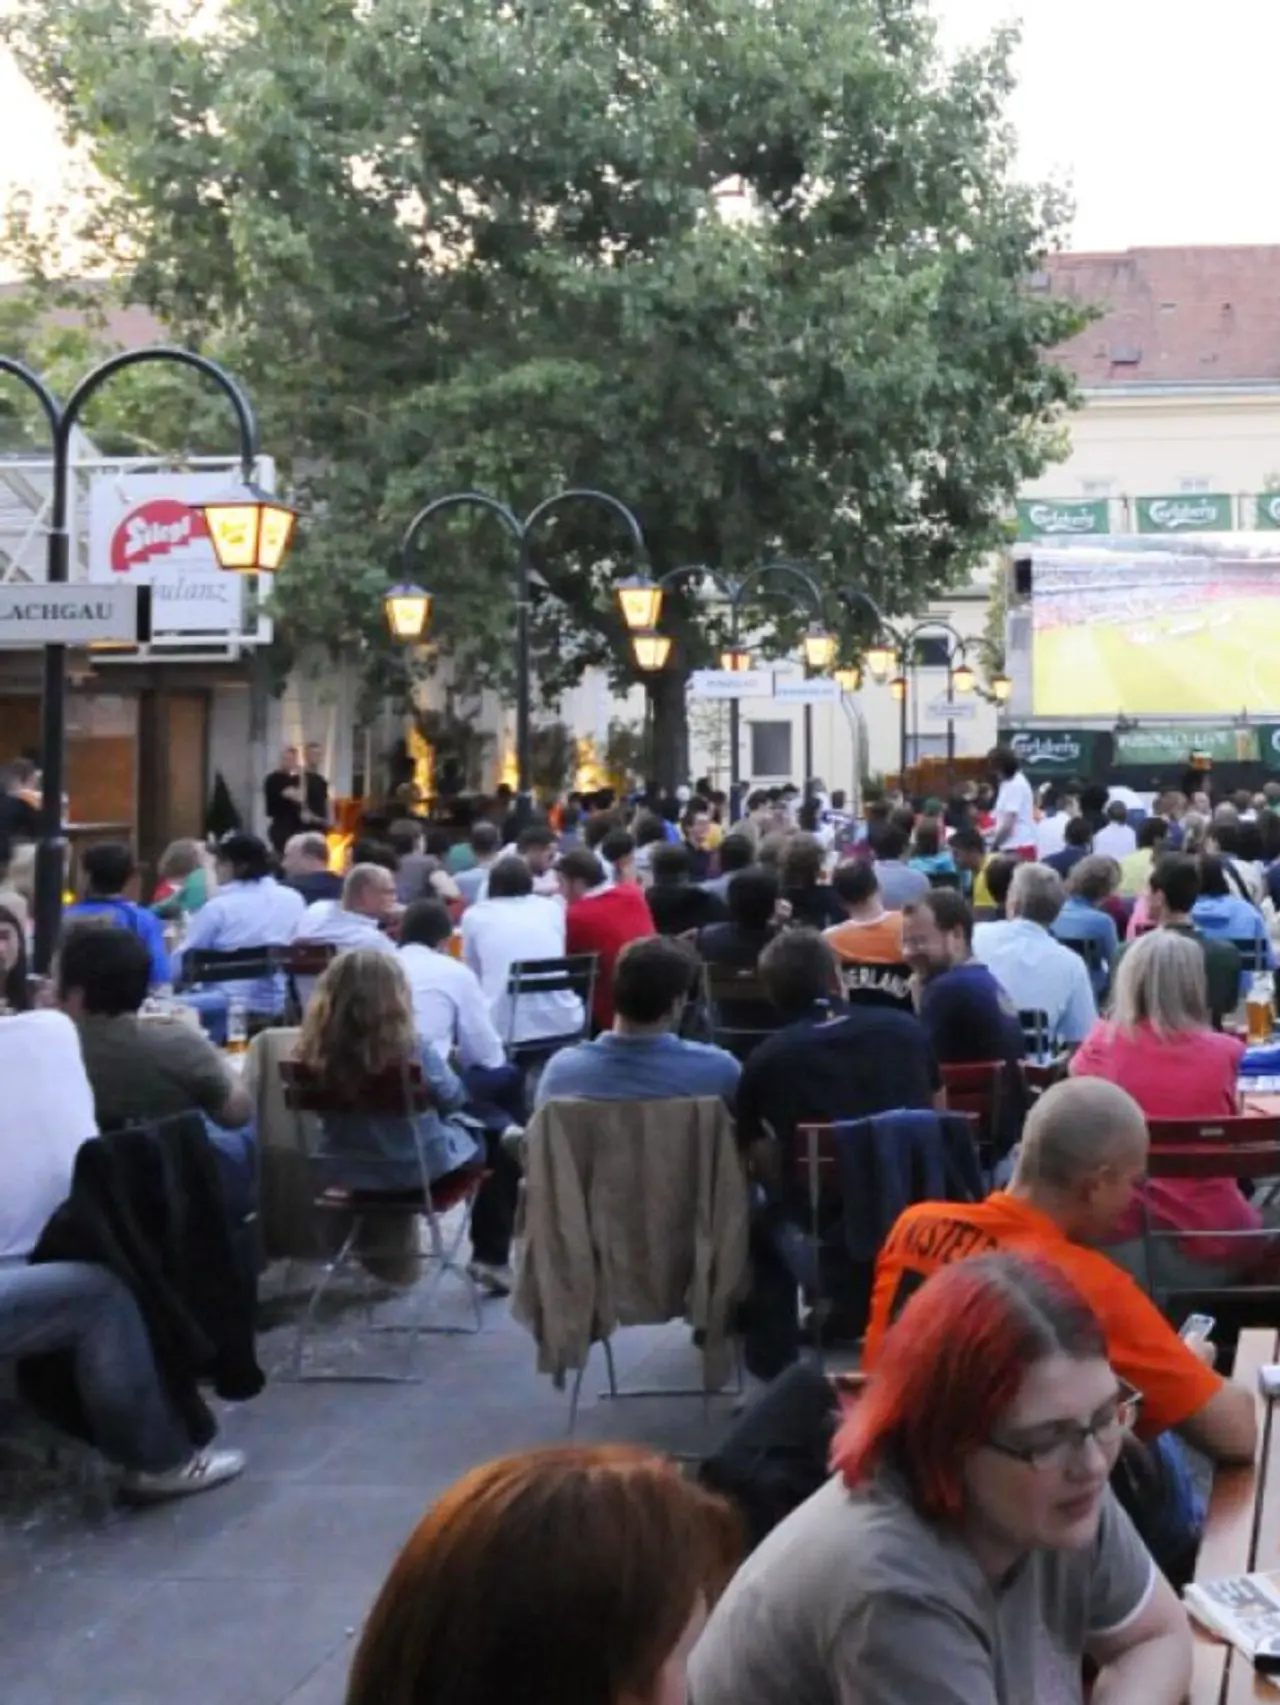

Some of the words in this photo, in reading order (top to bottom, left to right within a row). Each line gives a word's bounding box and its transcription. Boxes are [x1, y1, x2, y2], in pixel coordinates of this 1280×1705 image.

[1029, 505, 1095, 531] Carlsberg
[1149, 498, 1217, 527] Carlsberg
[1009, 731, 1080, 760] Carlsberg
